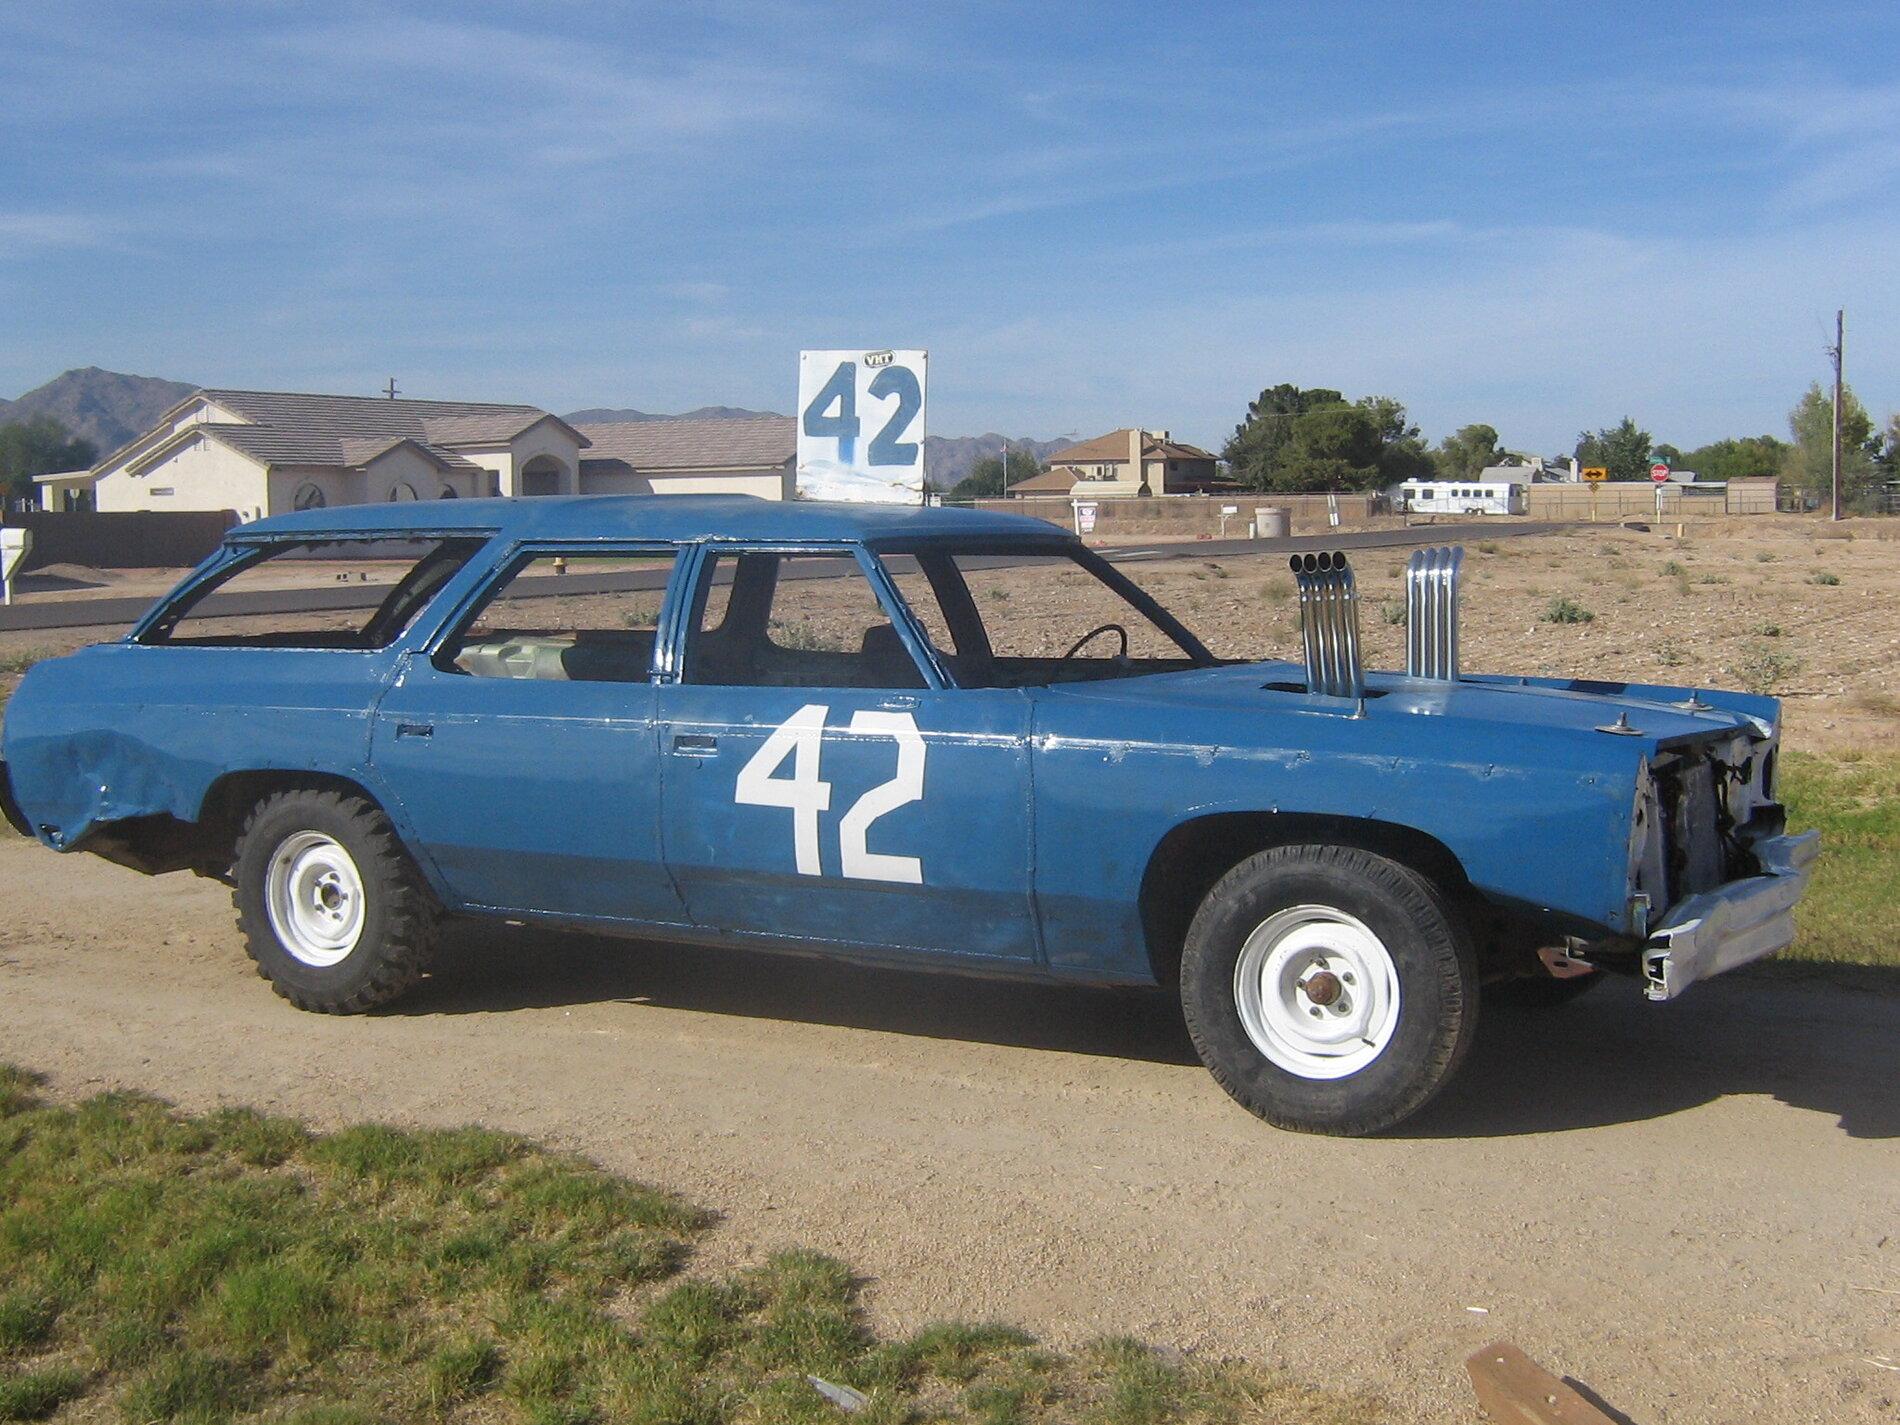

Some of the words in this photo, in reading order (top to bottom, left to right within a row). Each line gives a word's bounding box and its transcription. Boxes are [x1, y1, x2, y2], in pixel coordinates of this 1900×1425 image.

[865, 352, 892, 367] VHT
[804, 361, 921, 466] 42
[1652, 469, 1667, 477] STOP
[735, 704, 927, 884] 42
